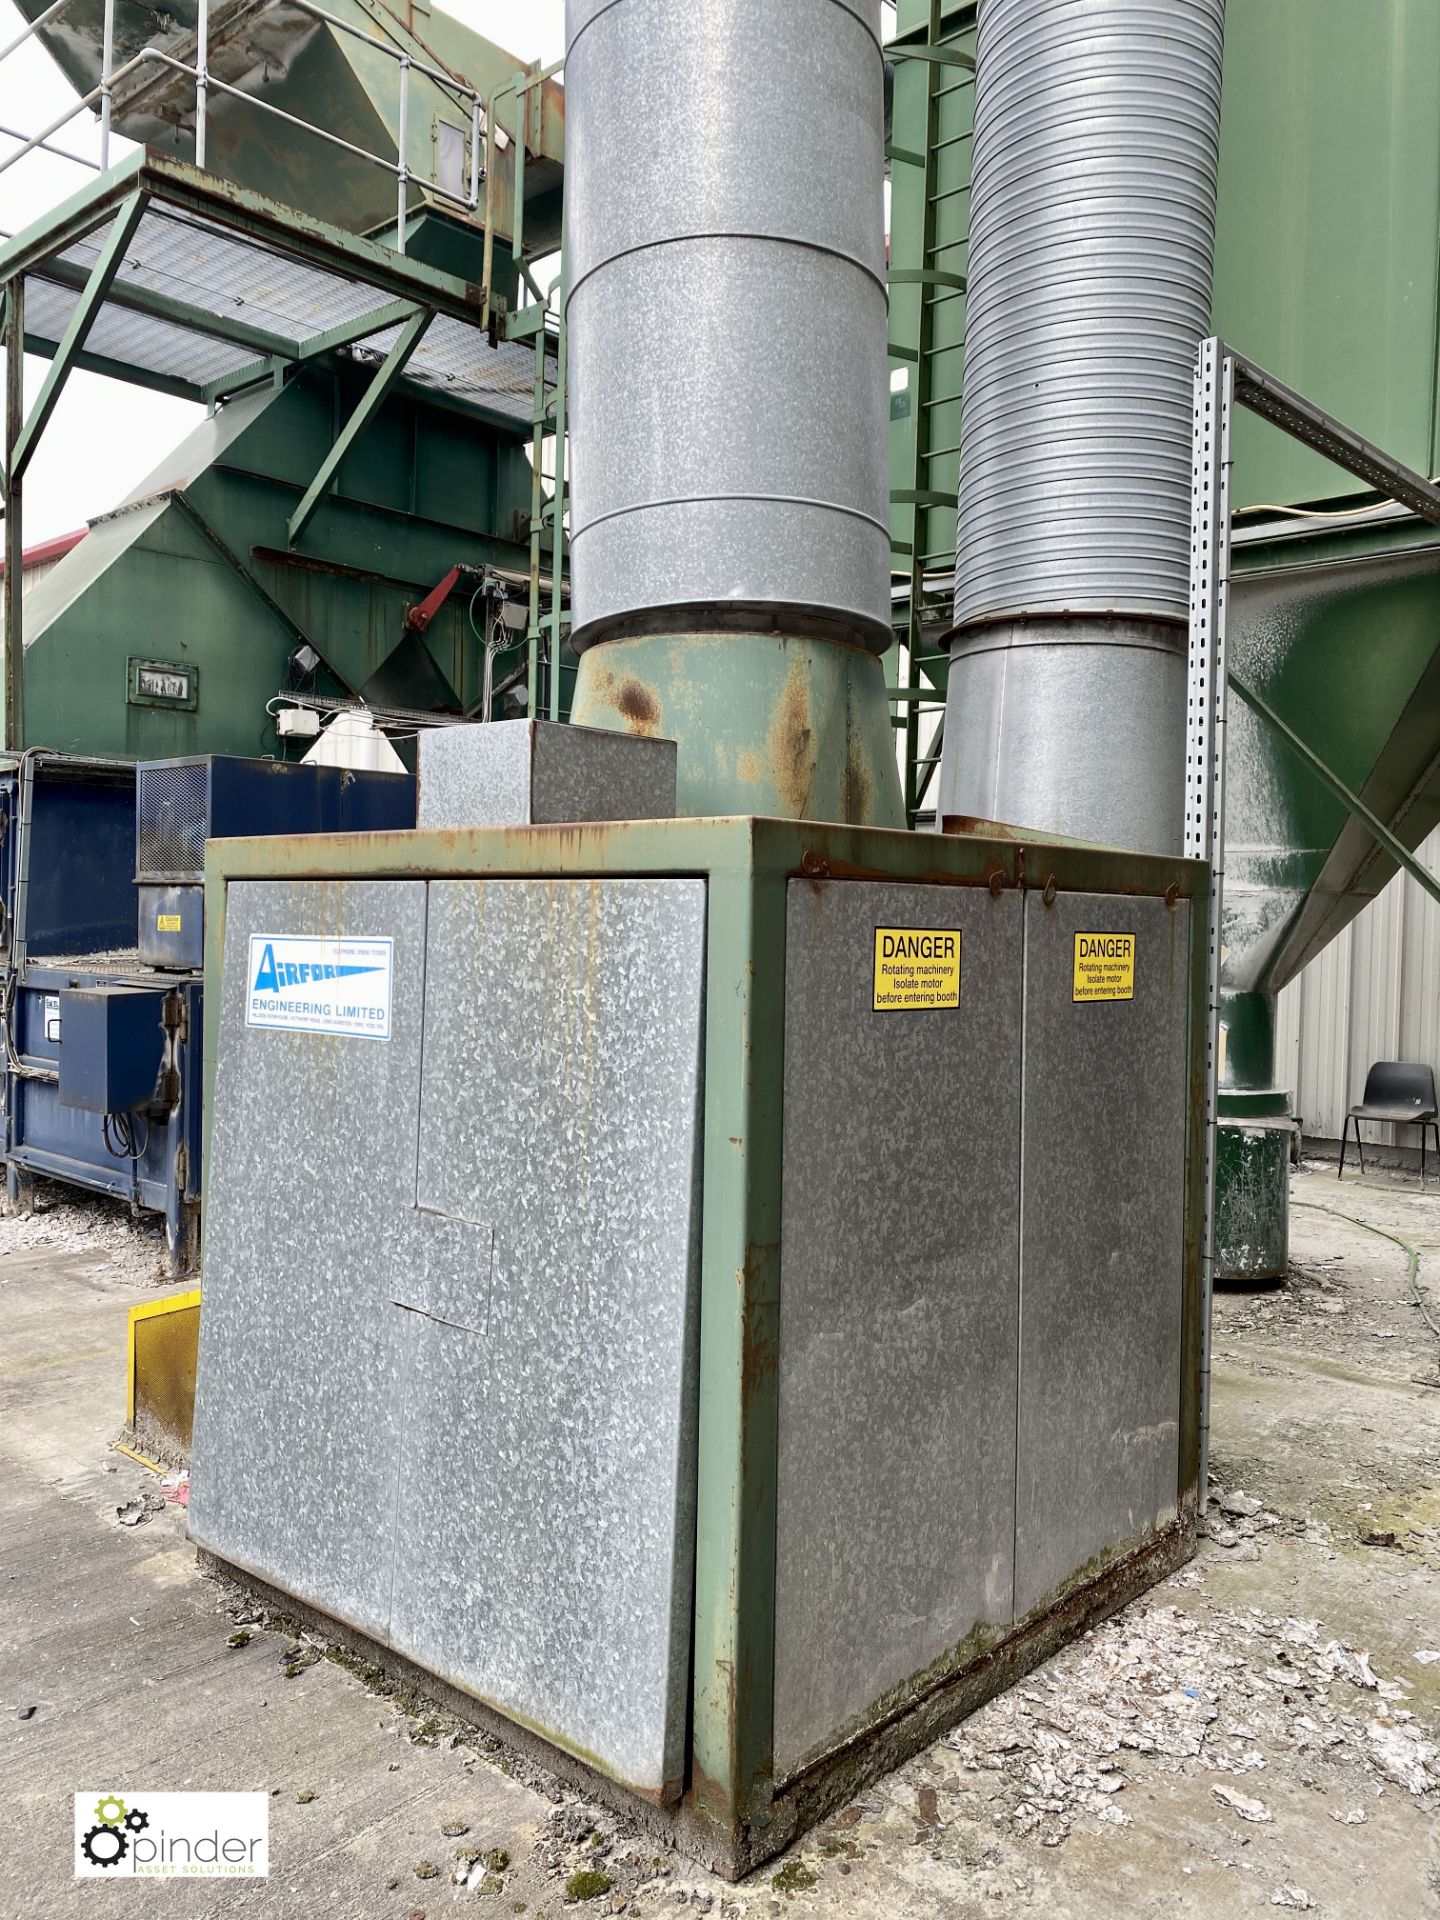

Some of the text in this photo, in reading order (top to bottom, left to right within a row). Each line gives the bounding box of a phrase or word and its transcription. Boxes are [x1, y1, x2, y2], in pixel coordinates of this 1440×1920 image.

[882, 935, 955, 959] DANGER
[1079, 938, 1131, 958] DANGER
[881, 963, 955, 977] Rotating machinery
[1078, 962, 1130, 974] Rotating machinery
[893, 978, 943, 989] Isolate motor
[1087, 974, 1122, 984] Isolate motor
[876, 990, 957, 1005] before entering booth
[1075, 984, 1132, 997] before entering booth
[252, 998, 384, 1020] ENGINEERING LIMITED
